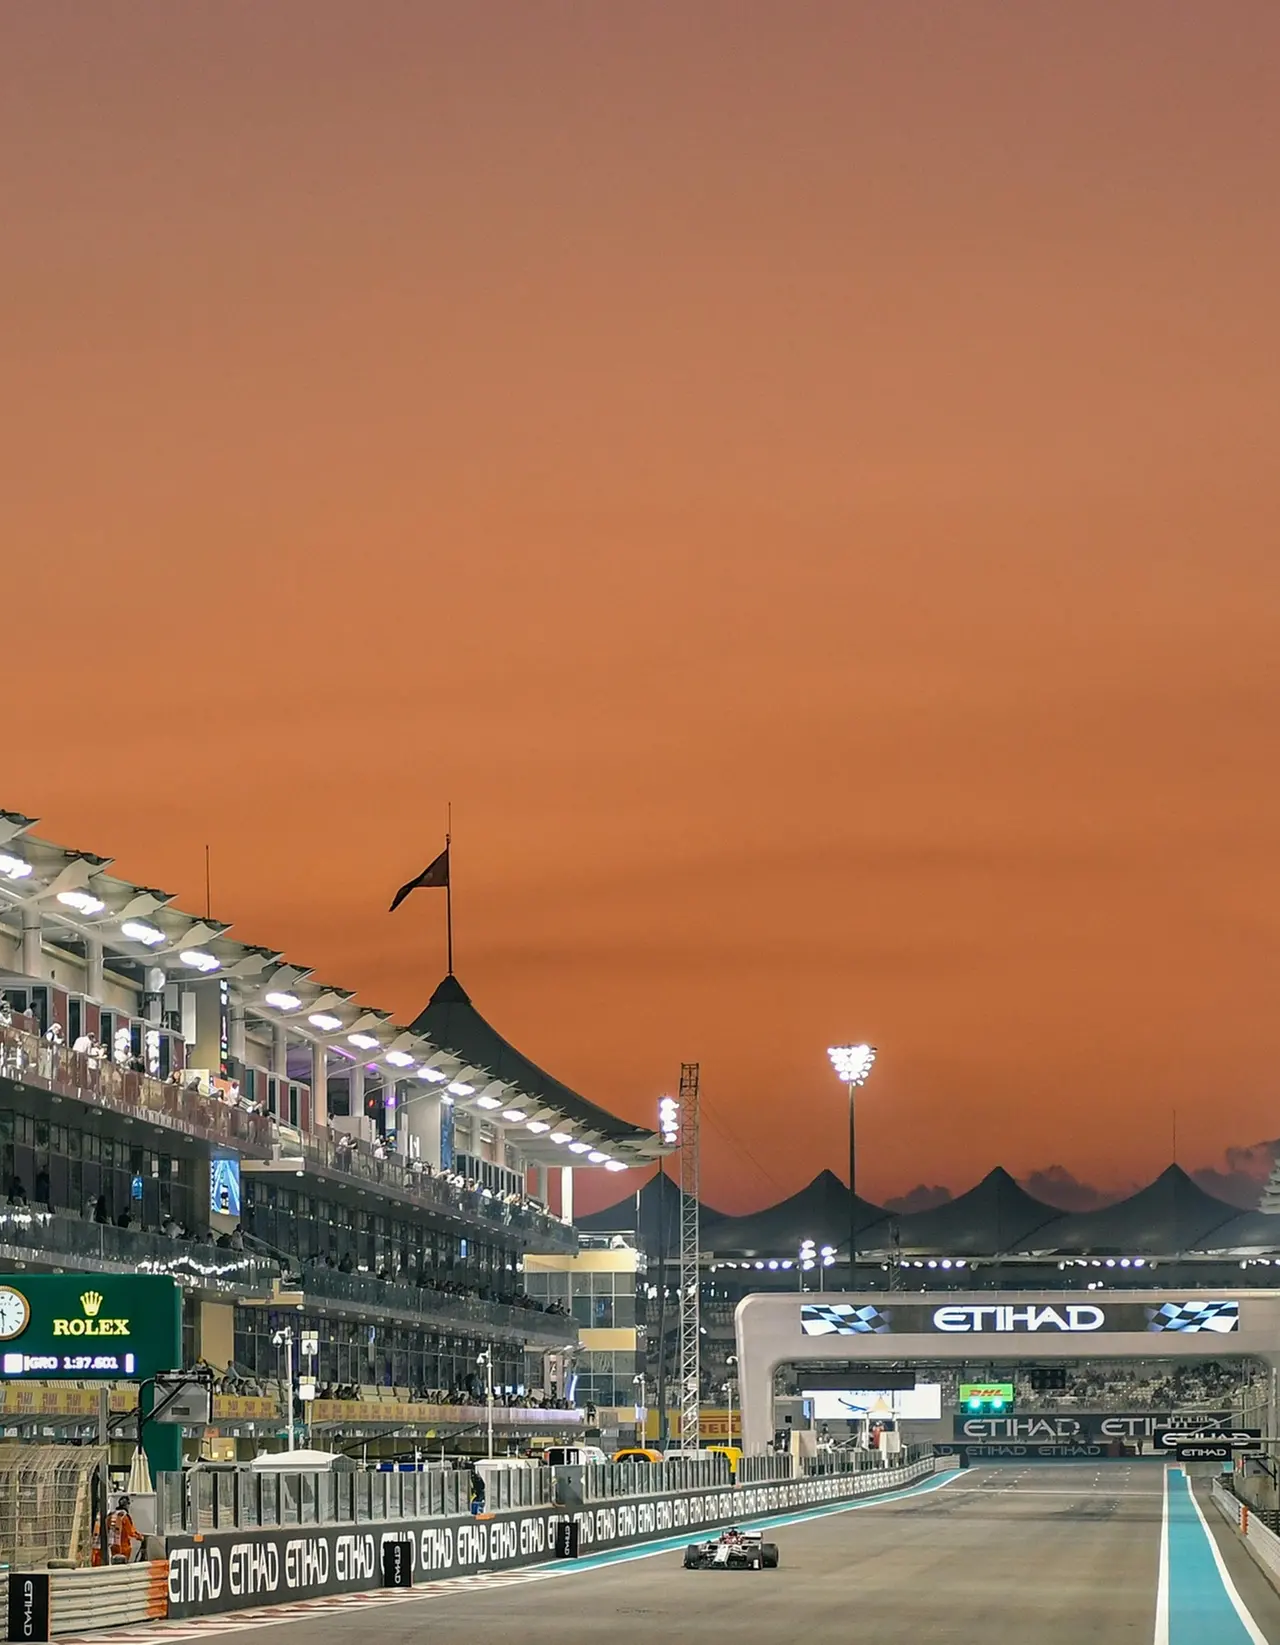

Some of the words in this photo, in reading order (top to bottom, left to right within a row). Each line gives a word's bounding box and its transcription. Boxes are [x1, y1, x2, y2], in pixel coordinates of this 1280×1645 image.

[53, 1318, 131, 1336] ROLEX
[933, 1305, 1105, 1331] ETIHAD
[963, 1418, 1081, 1437] ETIHAD
[966, 1446, 1027, 1455] ETIHAD
[1038, 1445, 1101, 1455] ETIHAD
[168, 1547, 223, 1603] ETIHAD
[229, 1542, 279, 1595] ETIHAD
[286, 1538, 328, 1588] ETIHAD
[335, 1534, 375, 1581] ETIHAD
[421, 1528, 453, 1570] ETIHAD
[457, 1525, 487, 1566] ETIHAD
[490, 1521, 517, 1560] ETIHAD
[521, 1517, 544, 1555] ETIHAD
[596, 1508, 616, 1540] ETIHAD
[618, 1505, 637, 1537] ETIHAD
[638, 1502, 656, 1533] ETIHAD
[23, 1579, 32, 1637] ETIHAD
